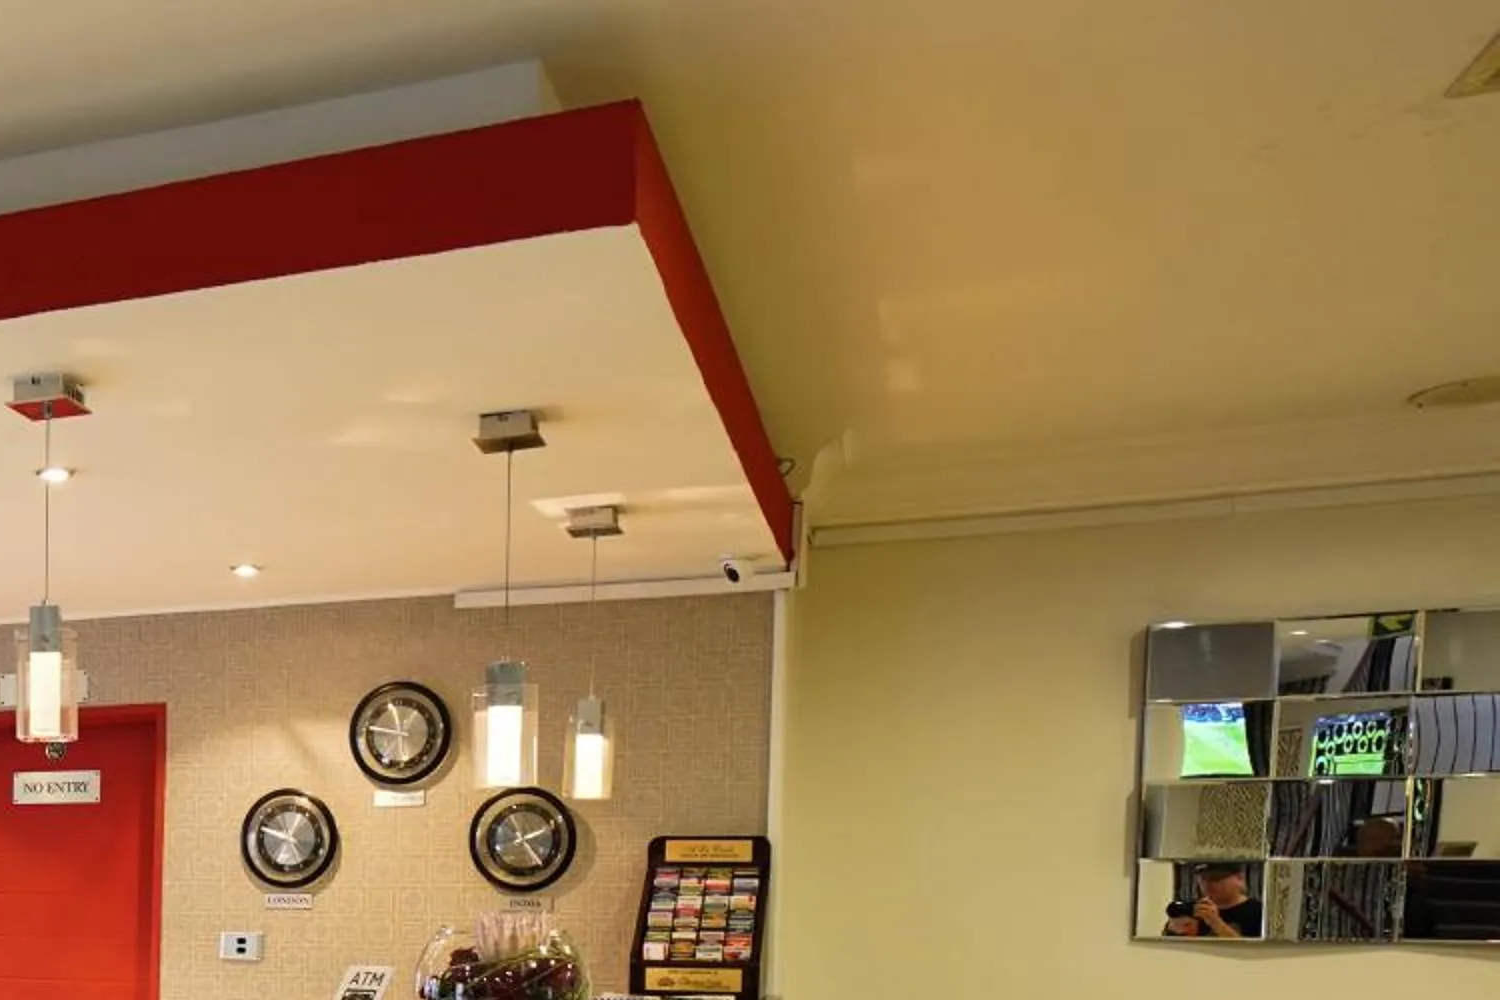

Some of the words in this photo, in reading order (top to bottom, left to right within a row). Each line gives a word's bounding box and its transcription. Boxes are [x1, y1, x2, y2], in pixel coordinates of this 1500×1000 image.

[24, 783, 43, 793] NO
[47, 781, 88, 793] ENTRY
[267, 896, 308, 904] LONDON
[349, 971, 385, 986] ATM
